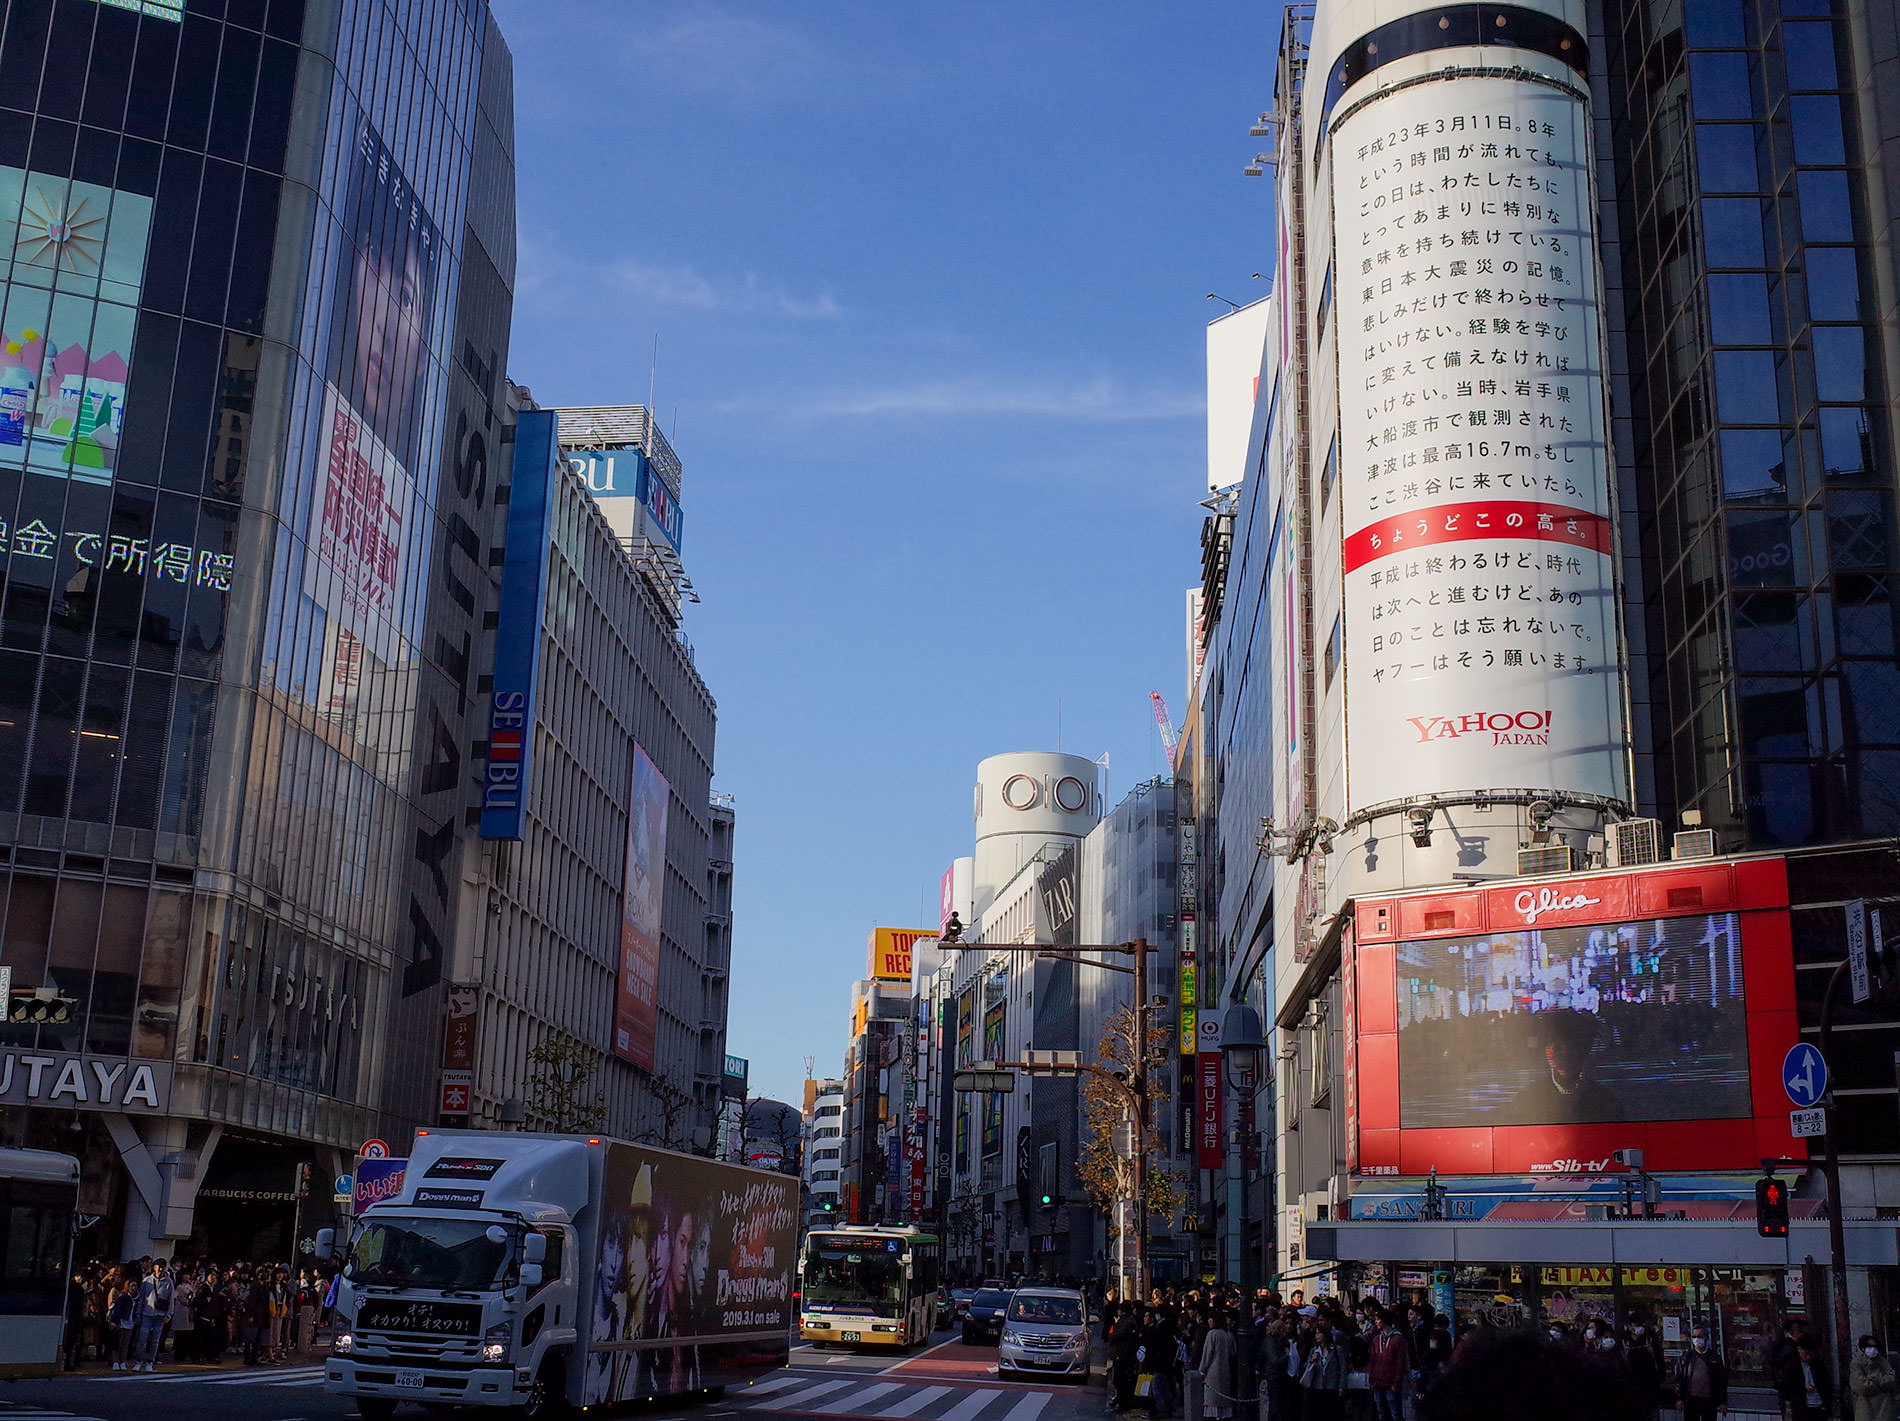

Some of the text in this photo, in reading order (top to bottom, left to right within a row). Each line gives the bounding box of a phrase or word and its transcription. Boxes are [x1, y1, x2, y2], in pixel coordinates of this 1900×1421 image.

[1356, 115, 1556, 162] 平成23年3月11日。8年
[1358, 143, 1564, 189] という時間が流れても、
[1359, 171, 1558, 217] この日は、わたしたちに
[1361, 199, 1560, 246] とってあまりに特別な
[1360, 229, 1569, 276] 意味を持ち続けている。
[1361, 258, 1571, 305] 東日本大震災の記憶。
[1362, 287, 1566, 333] 悲しみだけで終わらせて
[1364, 317, 1568, 362] はいけない。経験を学び
[1365, 348, 1569, 390] に変えて備えなければ
[1366, 378, 1571, 420] いけない。当時、岩手県
[1367, 409, 1573, 449] 大船渡市で観測された
[1367, 441, 1575, 481] 津波は最高16.7m。もし
[1369, 471, 1584, 511] ここ渋谷に来ていたら、
[1370, 512, 1587, 549] ちょうどこの高さ。
[1370, 552, 1582, 589] 平成は終わるけど、時代
[1372, 585, 1582, 620] は次へと進むけど、あの
[1373, 617, 1592, 652] 日のことは忘れないで。
[1373, 648, 1593, 684] ヤフーはそう願います。
[1406, 710, 1553, 744] YAHOO!
[1492, 731, 1549, 747] JAPAN
[485, 691, 524, 809] SEIBU
[446, 1087, 466, 1108] 本
[1204, 1061, 1217, 1149] 三菱UFJ銀行
[256, 1191, 296, 1201] COFFEE
[754, 1312, 765, 1325] on
[765, 1309, 781, 1325] sale
